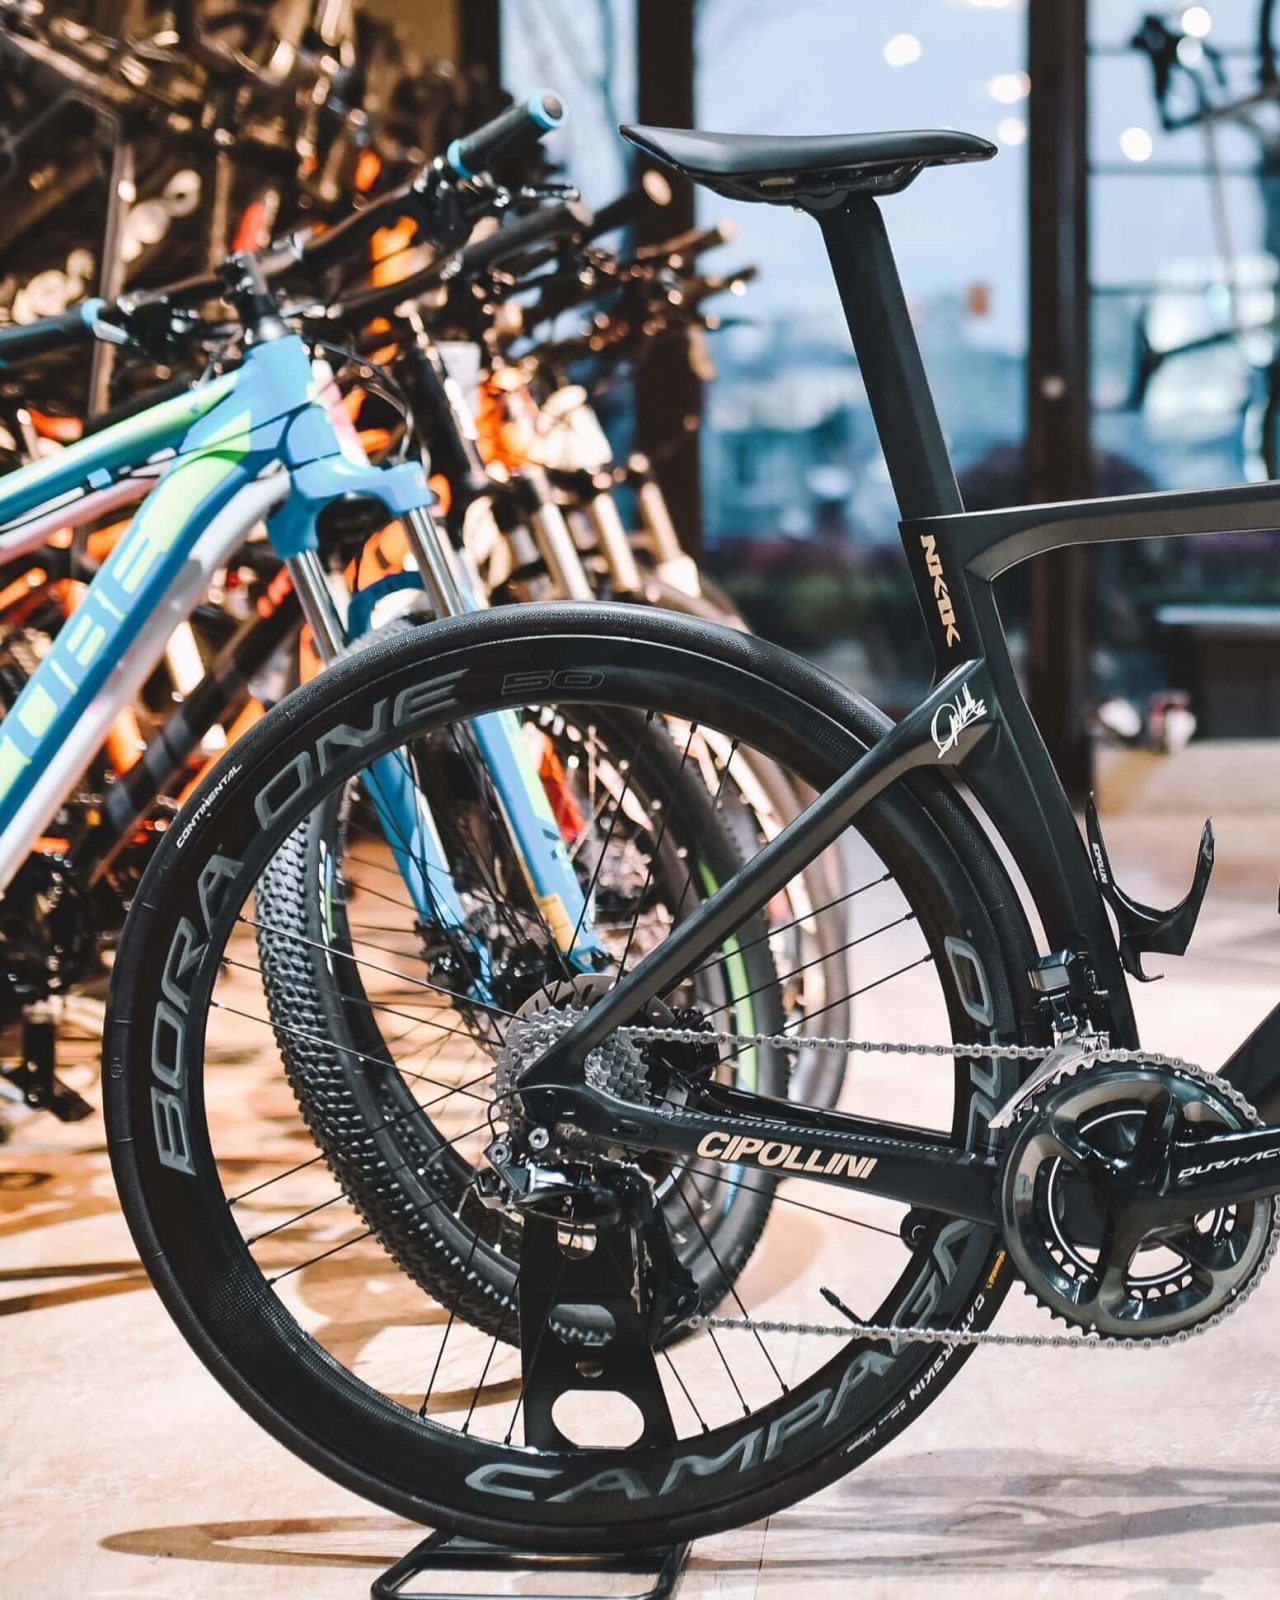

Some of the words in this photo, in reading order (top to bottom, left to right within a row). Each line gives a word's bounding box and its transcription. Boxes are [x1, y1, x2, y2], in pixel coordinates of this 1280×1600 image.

[175, 763, 243, 850] CONTINENTAL
[150, 853, 245, 1176] BORA
[254, 668, 470, 831] ONE
[501, 669, 605, 696] 50
[696, 1130, 878, 1180] CIPOLLINI
